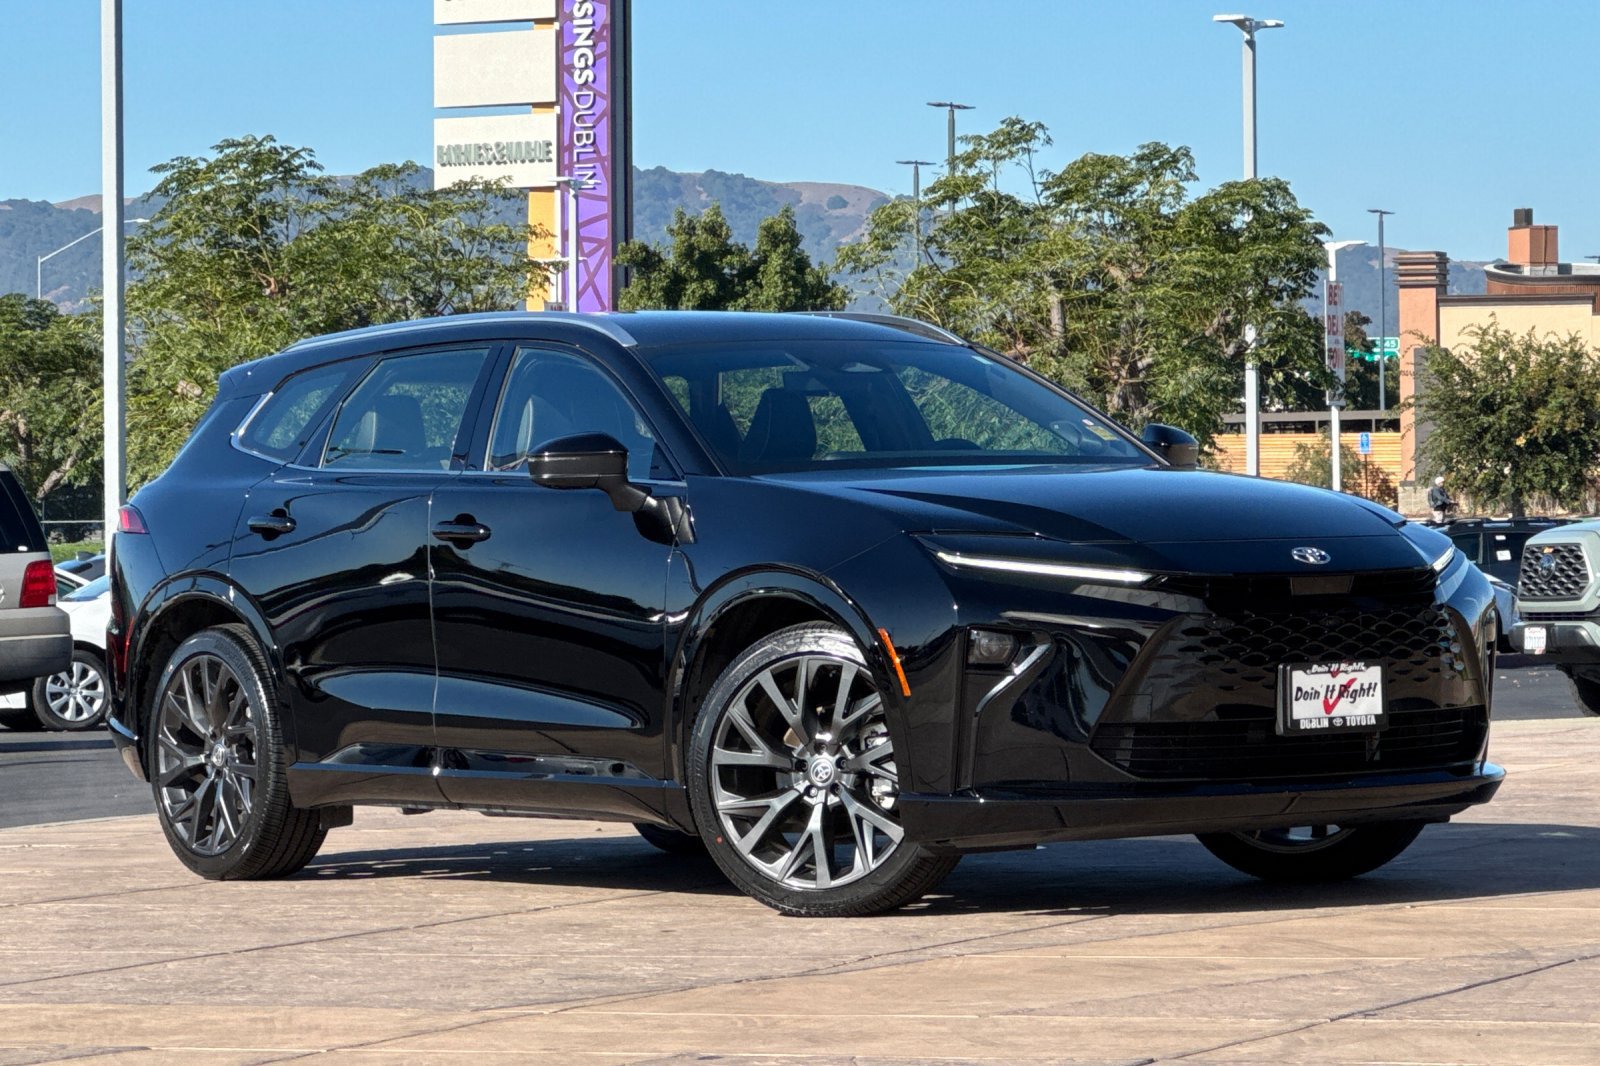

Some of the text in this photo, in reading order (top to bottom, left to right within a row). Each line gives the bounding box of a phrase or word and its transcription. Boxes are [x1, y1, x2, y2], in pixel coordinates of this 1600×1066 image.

[573, 0, 595, 189] SINGS DUBLIN
[1294, 682, 1378, 704] Doin' It Right!
[1300, 714, 1376, 729] DUBLIN TOYOTA
